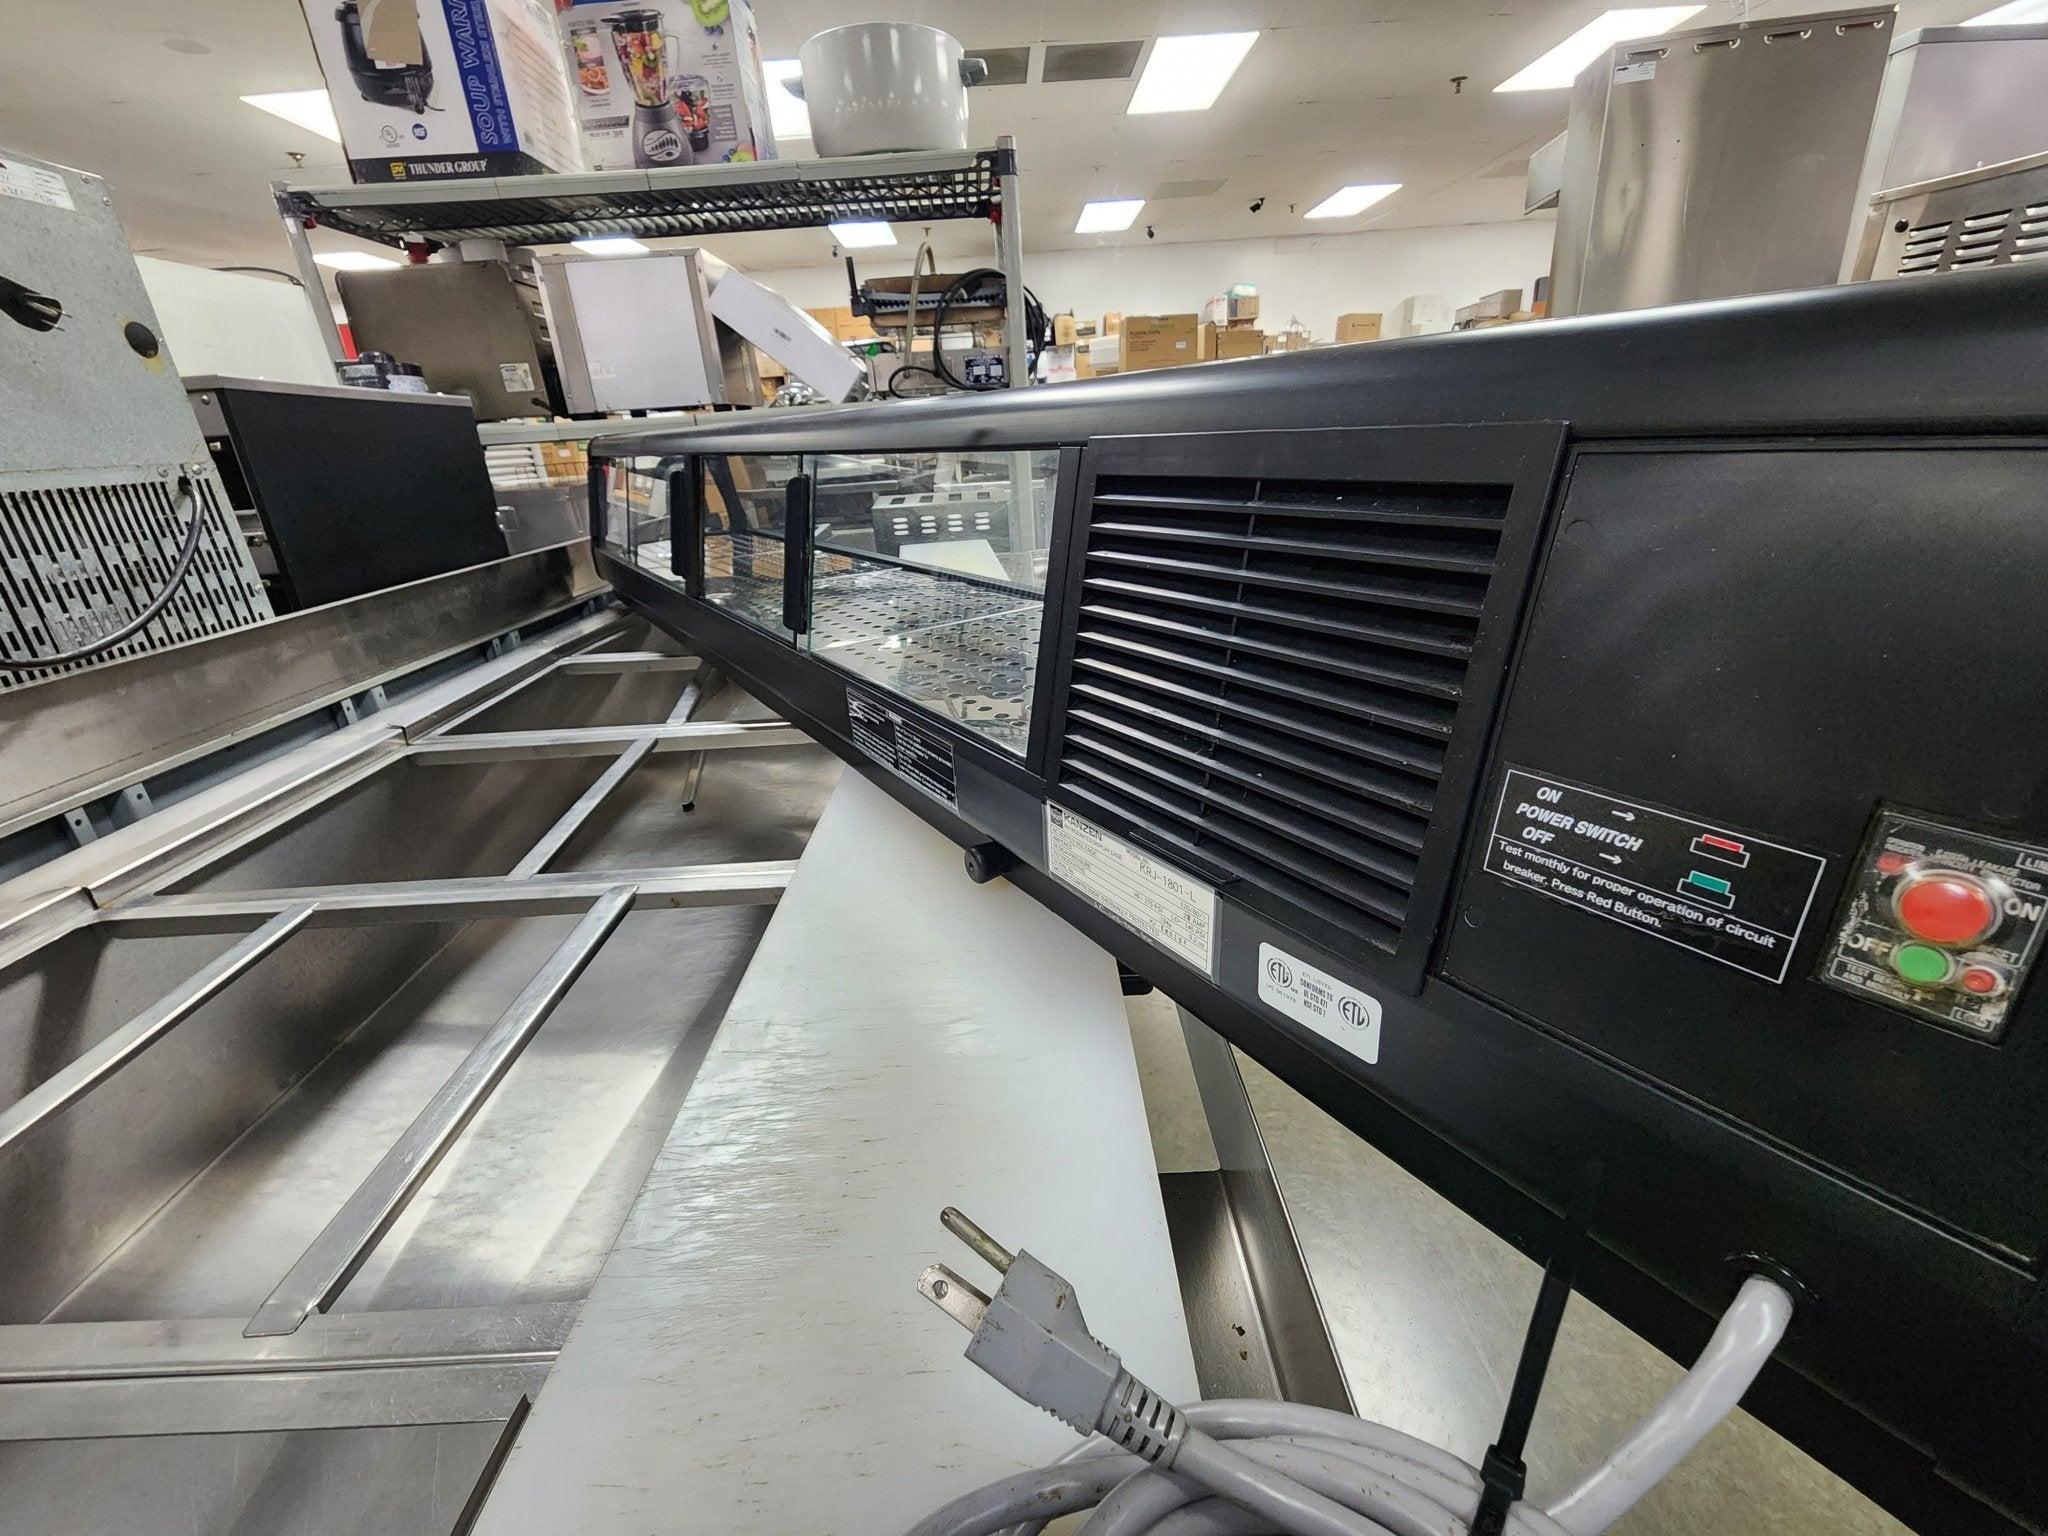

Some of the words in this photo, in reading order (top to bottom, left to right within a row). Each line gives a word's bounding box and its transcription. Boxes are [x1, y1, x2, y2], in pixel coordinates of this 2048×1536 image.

[467, 75, 499, 145] SOUP
[408, 162, 454, 176] THUNDER
[455, 160, 486, 174] GROUP
[1535, 784, 1562, 805] ON
[1064, 812, 1102, 842] KANZEN
[1515, 801, 1573, 830] POWER
[1574, 819, 1643, 852] SWITCH
[1521, 824, 1554, 846] OFF
[1139, 861, 1196, 903] KRJ-1801-L
[1498, 840, 1522, 857] Test
[1523, 849, 1570, 875] monthly
[1571, 866, 1591, 881] for
[1591, 874, 1635, 899] proper
[1636, 889, 1705, 923] operation
[1704, 913, 1724, 929] of
[1723, 920, 1776, 948] circuit
[1502, 859, 1549, 885] breaker.
[1550, 878, 1585, 899] Press
[1585, 891, 1612, 909] Red
[1612, 901, 1663, 928] Button.
[2004, 898, 2042, 922] ON
[1848, 932, 1892, 956] OFF
[1270, 962, 1288, 984] ETL
[1299, 977, 1326, 998] CONFORMS
[1326, 991, 1332, 1002] TO
[1303, 988, 1309, 999] UL
[1309, 992, 1319, 1004] STD
[1312, 1003, 1322, 1016] STD
[1342, 1001, 1365, 1026] ETL
